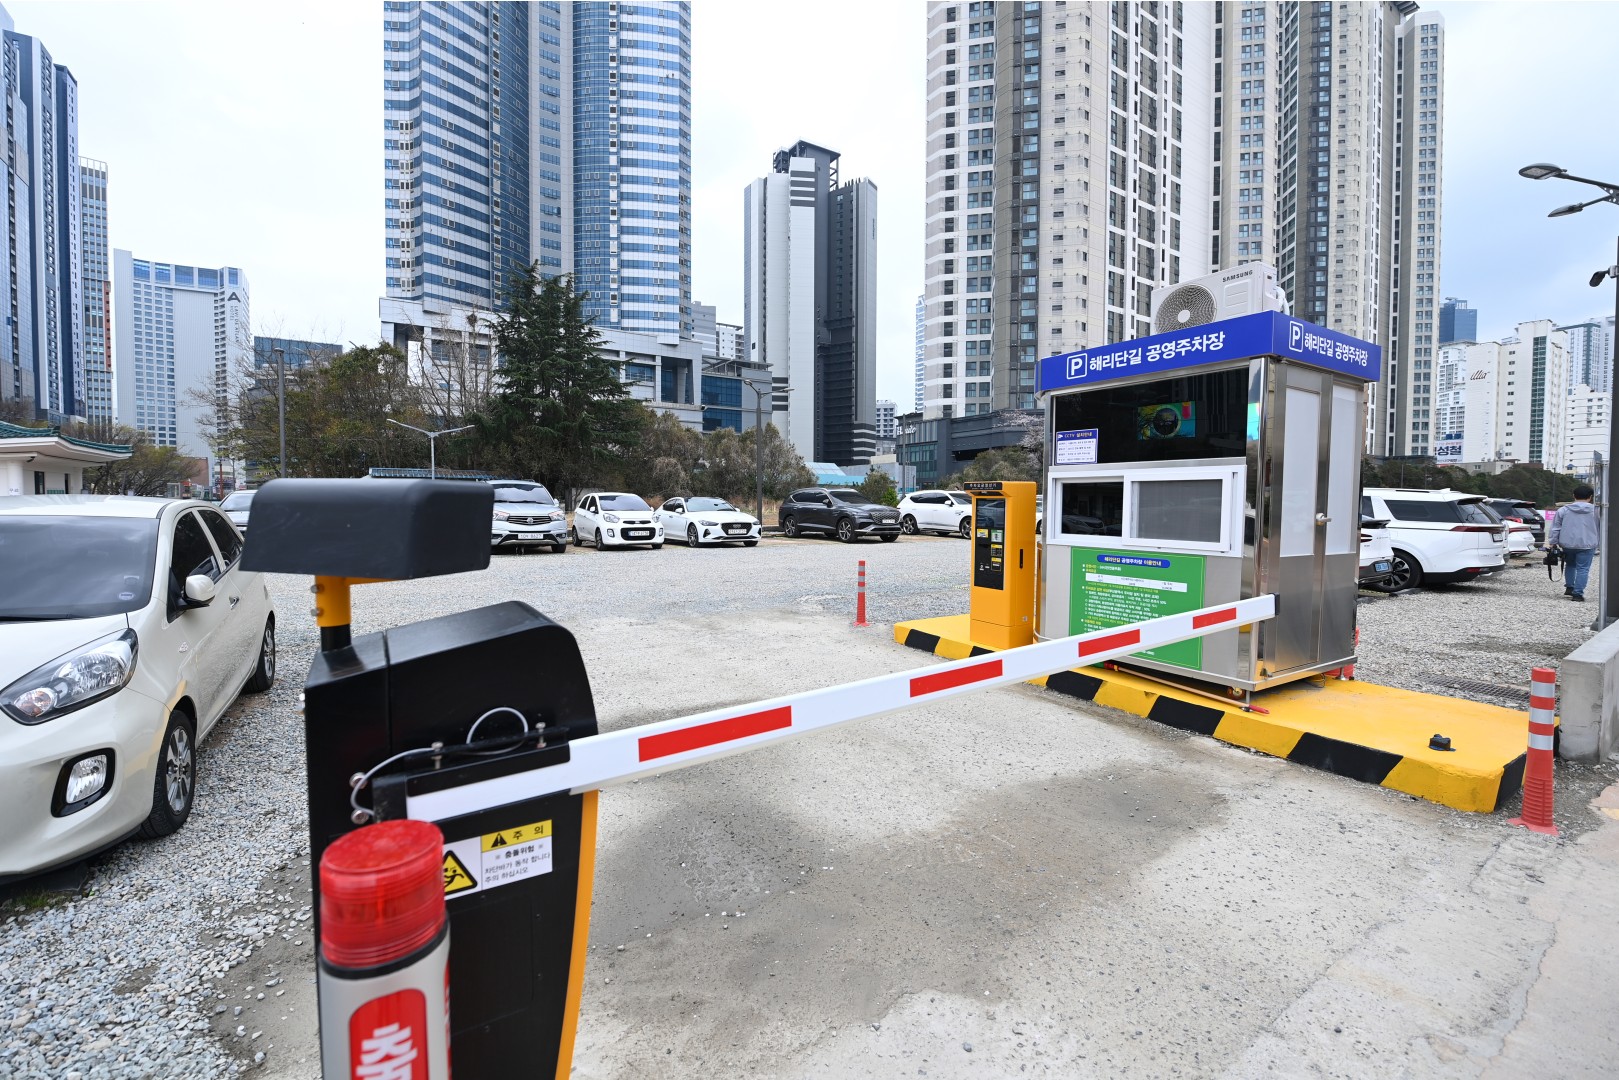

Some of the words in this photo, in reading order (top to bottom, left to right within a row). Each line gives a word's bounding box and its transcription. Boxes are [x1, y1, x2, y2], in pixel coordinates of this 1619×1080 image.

[1222, 269, 1253, 283] SAMSUNG
[1089, 347, 1142, 371] 해리단길
[1145, 330, 1226, 362] 공영주차장
[1304, 332, 1334, 357] 해리단길
[1334, 341, 1369, 367] 공영주차장
